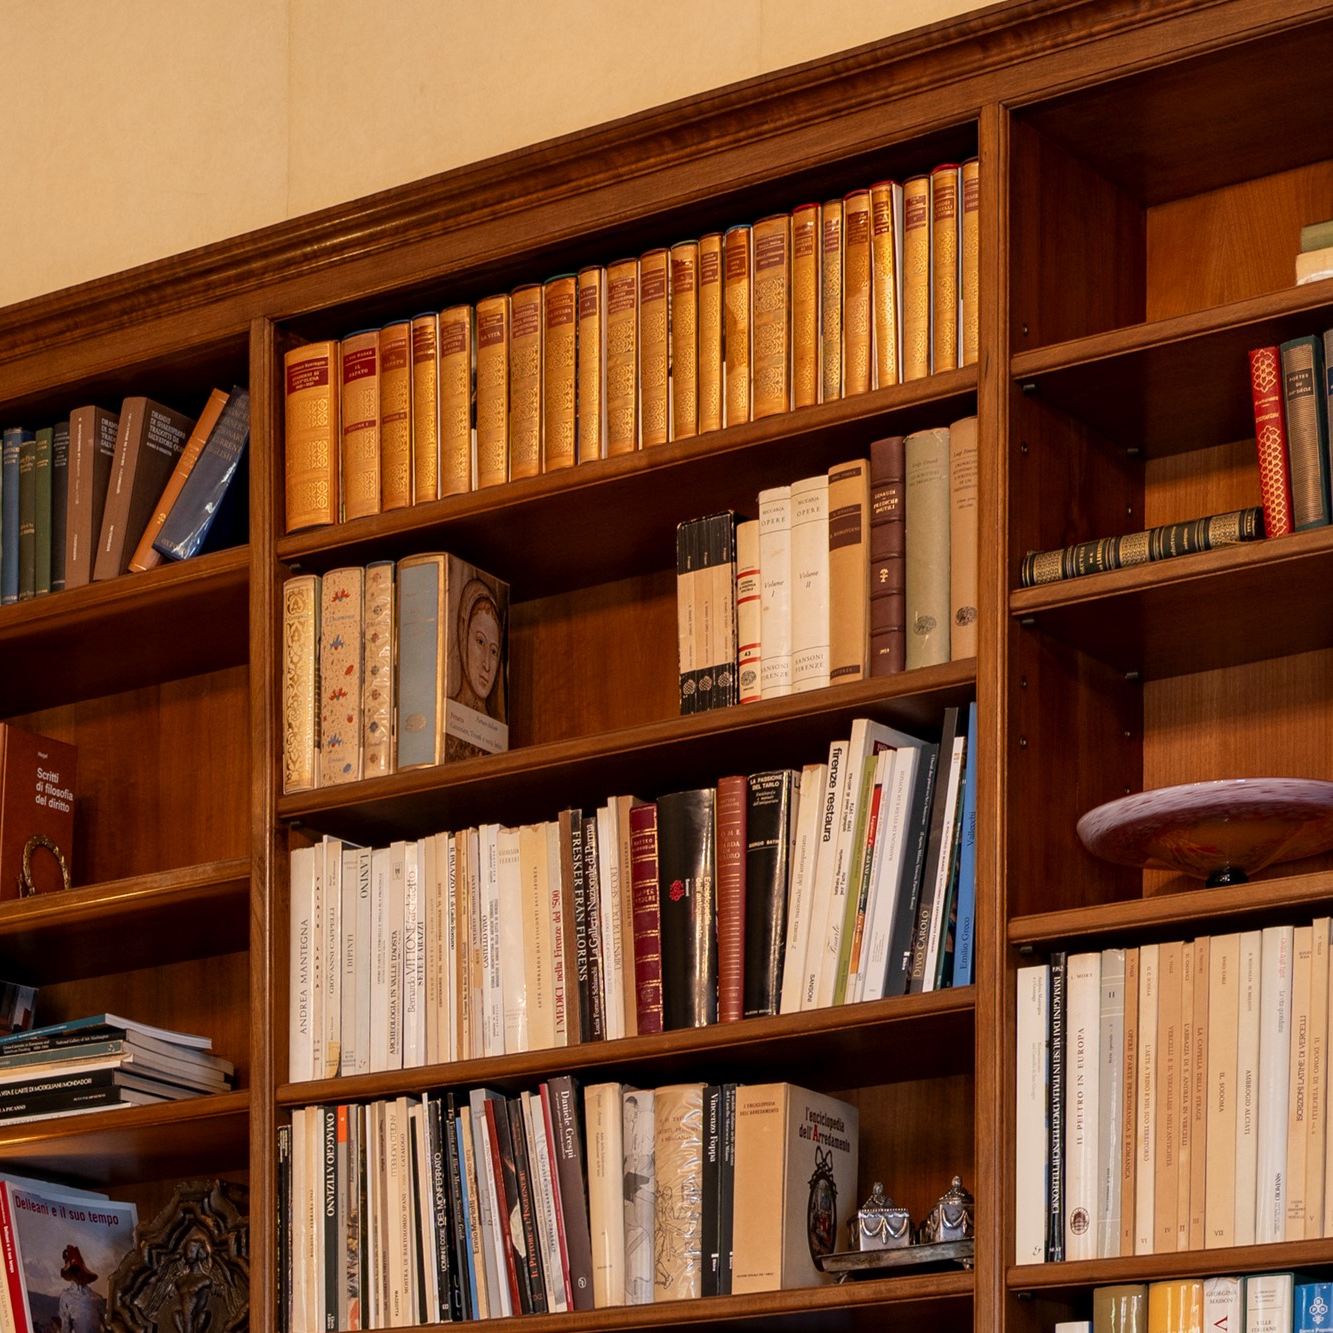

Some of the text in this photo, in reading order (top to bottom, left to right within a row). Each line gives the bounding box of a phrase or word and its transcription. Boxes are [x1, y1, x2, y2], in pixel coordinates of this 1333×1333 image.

[761, 516, 785, 527] OPERE
[796, 506, 821, 517] OPERE
[36, 782, 74, 801] di filosofia
[37, 767, 59, 783] Scritti
[757, 775, 782, 783] PASSIONE
[35, 794, 70, 813] del diritto
[823, 748, 842, 842] firenze restaura
[966, 811, 977, 847] Vallecchi
[572, 830, 583, 885] FRESKER
[360, 854, 369, 898] LANINO
[585, 824, 598, 961] La Galleria Nazionale di Parma
[552, 911, 561, 924] del
[553, 926, 562, 958] Firenze
[576, 926, 588, 981] FLORENS
[913, 910, 930, 977] DIVO CAROLO
[959, 917, 970, 970] Emilio Greco
[299, 919, 308, 1035] ANDREA MANTEGNA
[554, 961, 563, 982] nella
[807, 974, 816, 1002] SANSONI
[390, 989, 397, 998] IN
[555, 986, 564, 1025] MEDICI
[389, 1000, 397, 1055] ARCHEOLOGIA
[560, 1090, 577, 1160] Daniele Crespi
[708, 1093, 719, 1162] Vincenzo Foppa
[805, 1106, 845, 1133] l'enciclopedia
[798, 1124, 850, 1153] dell'Arredamento
[326, 1113, 336, 1217] OMAGGIO A TIZIANO
[15, 1195, 119, 1226] Delleani e il suo tempo
